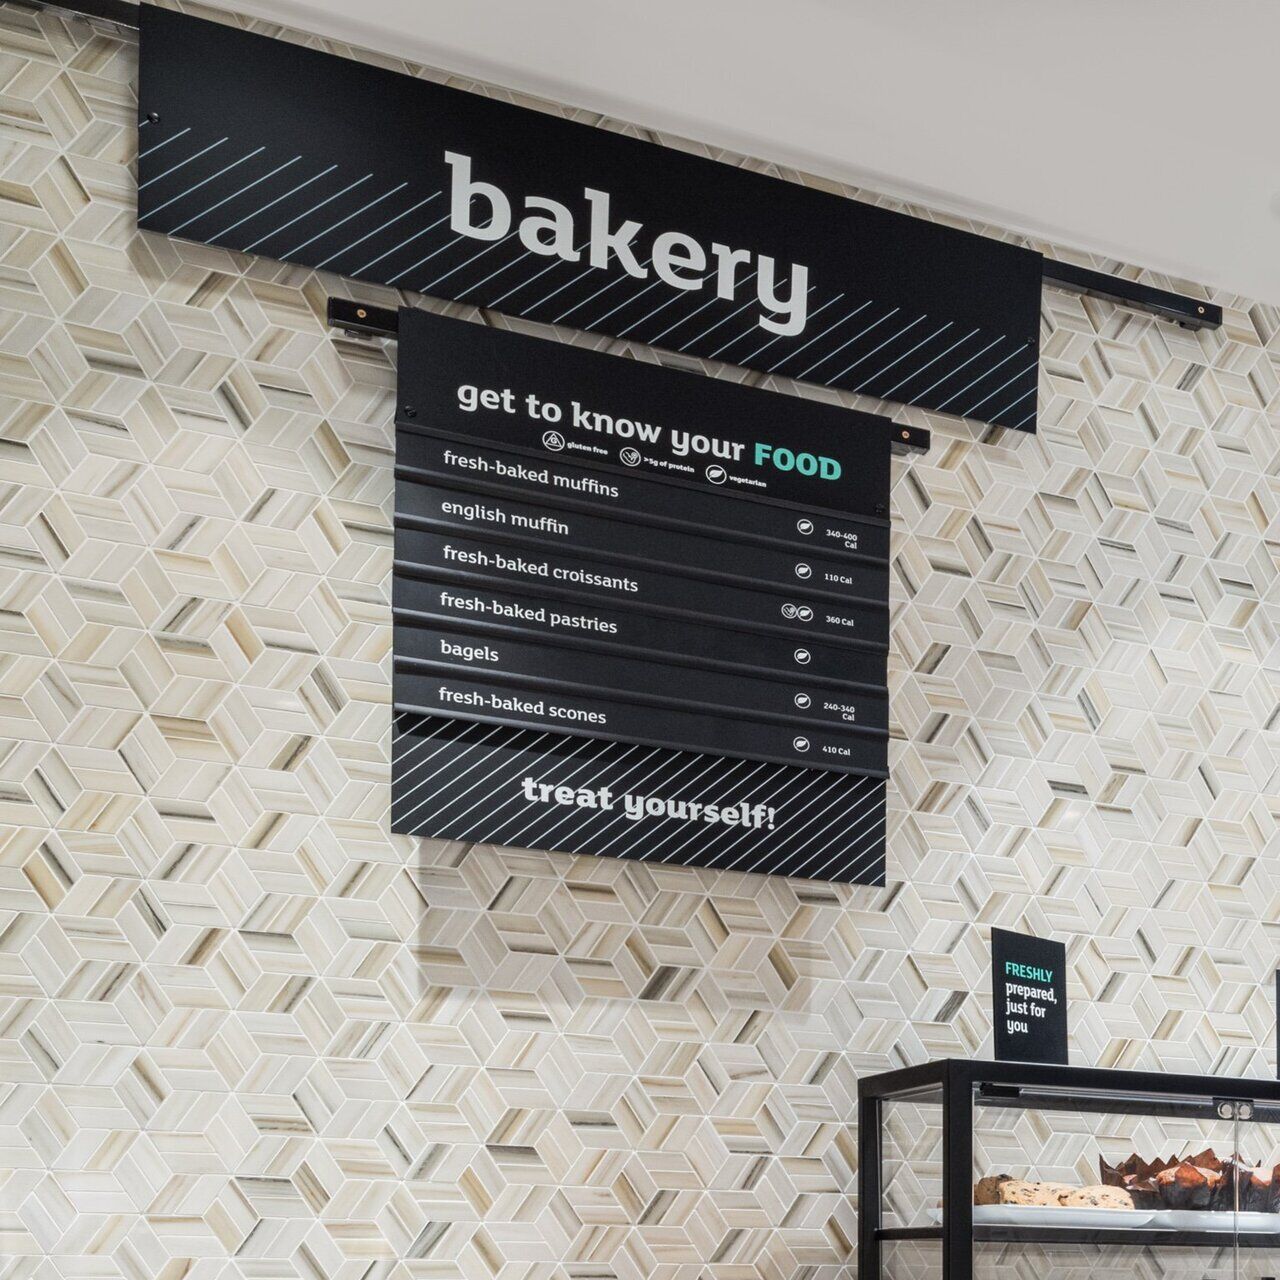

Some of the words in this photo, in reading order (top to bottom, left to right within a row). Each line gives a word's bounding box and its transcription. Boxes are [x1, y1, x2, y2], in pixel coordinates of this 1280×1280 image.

[444, 150, 810, 337] bakery
[457, 384, 515, 414] get
[526, 394, 562, 422] to
[572, 400, 661, 443] know
[671, 428, 745, 462] your
[755, 442, 842, 480] FOOD
[567, 441, 591, 452] gluten
[592, 444, 608, 455] free
[443, 450, 549, 484] fresh-baked
[553, 473, 619, 498] muffins
[659, 459, 668, 467] of
[669, 462, 695, 473] protein
[729, 475, 767, 488] vegetarian
[441, 501, 506, 526] english
[511, 511, 569, 535] muffin
[826, 529, 858, 541] 340-400
[845, 541, 857, 549] Cal
[443, 545, 549, 578] fresh-baked
[553, 567, 639, 592] croissants
[824, 573, 839, 582] 110
[840, 575, 853, 584] Cal
[440, 592, 546, 622] fresh-baked
[550, 612, 618, 633] pastries
[826, 616, 840, 625] 360
[841, 618, 854, 627] Cal
[440, 640, 499, 662] bagels
[439, 687, 544, 715] fresh-baked
[549, 705, 607, 724] scones
[823, 702, 855, 713] 240-340
[842, 713, 855, 721] Cal
[822, 746, 837, 754] 410
[838, 747, 851, 755] Cal
[521, 776, 613, 811] treat
[624, 792, 776, 830] yourself!
[1005, 961, 1053, 983] FRESHLY
[1005, 981, 1058, 1004] prepared,
[1005, 998, 1028, 1016] just
[1030, 1003, 1046, 1018] for
[1006, 1018, 1028, 1035] you
